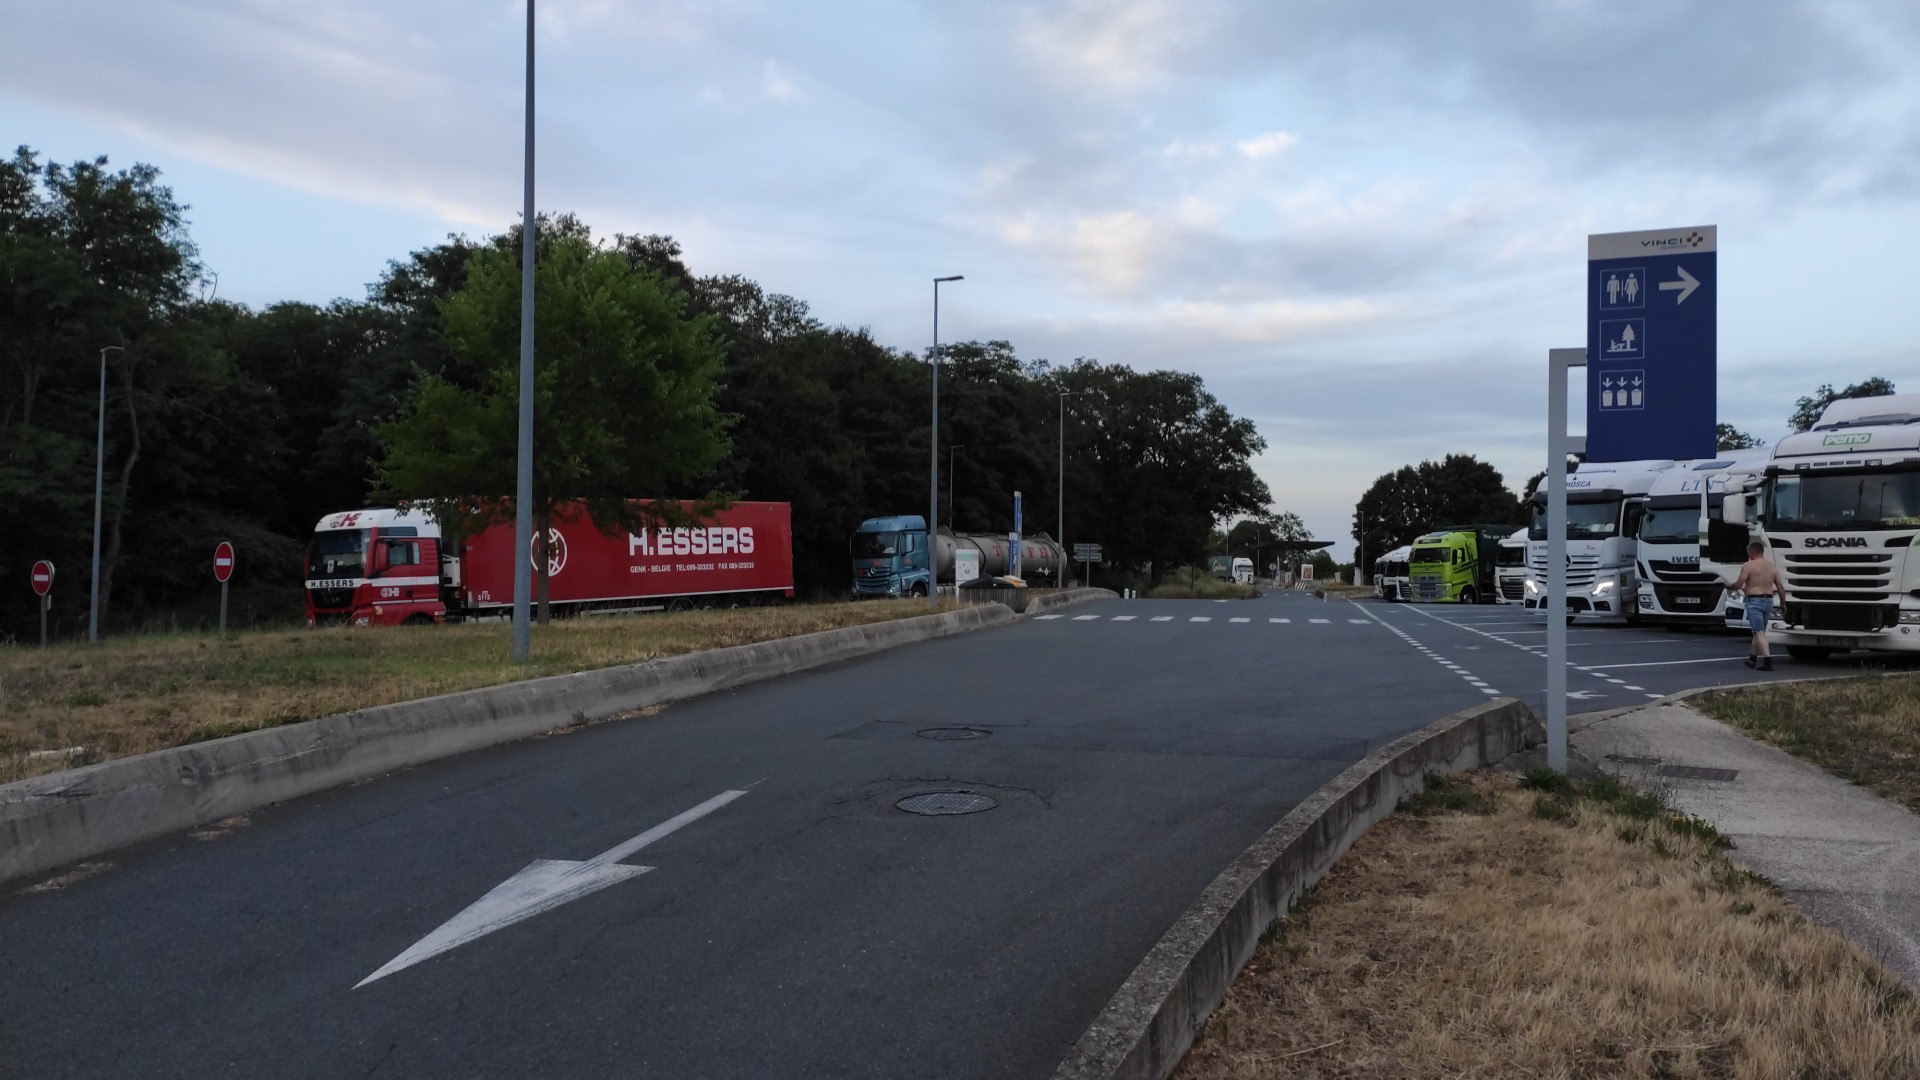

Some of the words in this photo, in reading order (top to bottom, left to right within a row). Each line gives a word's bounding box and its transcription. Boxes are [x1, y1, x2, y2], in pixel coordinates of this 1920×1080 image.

[1641, 238, 1683, 247] VINCI
[1804, 537, 1868, 548] SCANIA
[630, 565, 646, 573] GENK
[311, 580, 354, 588] H.ESSERS
